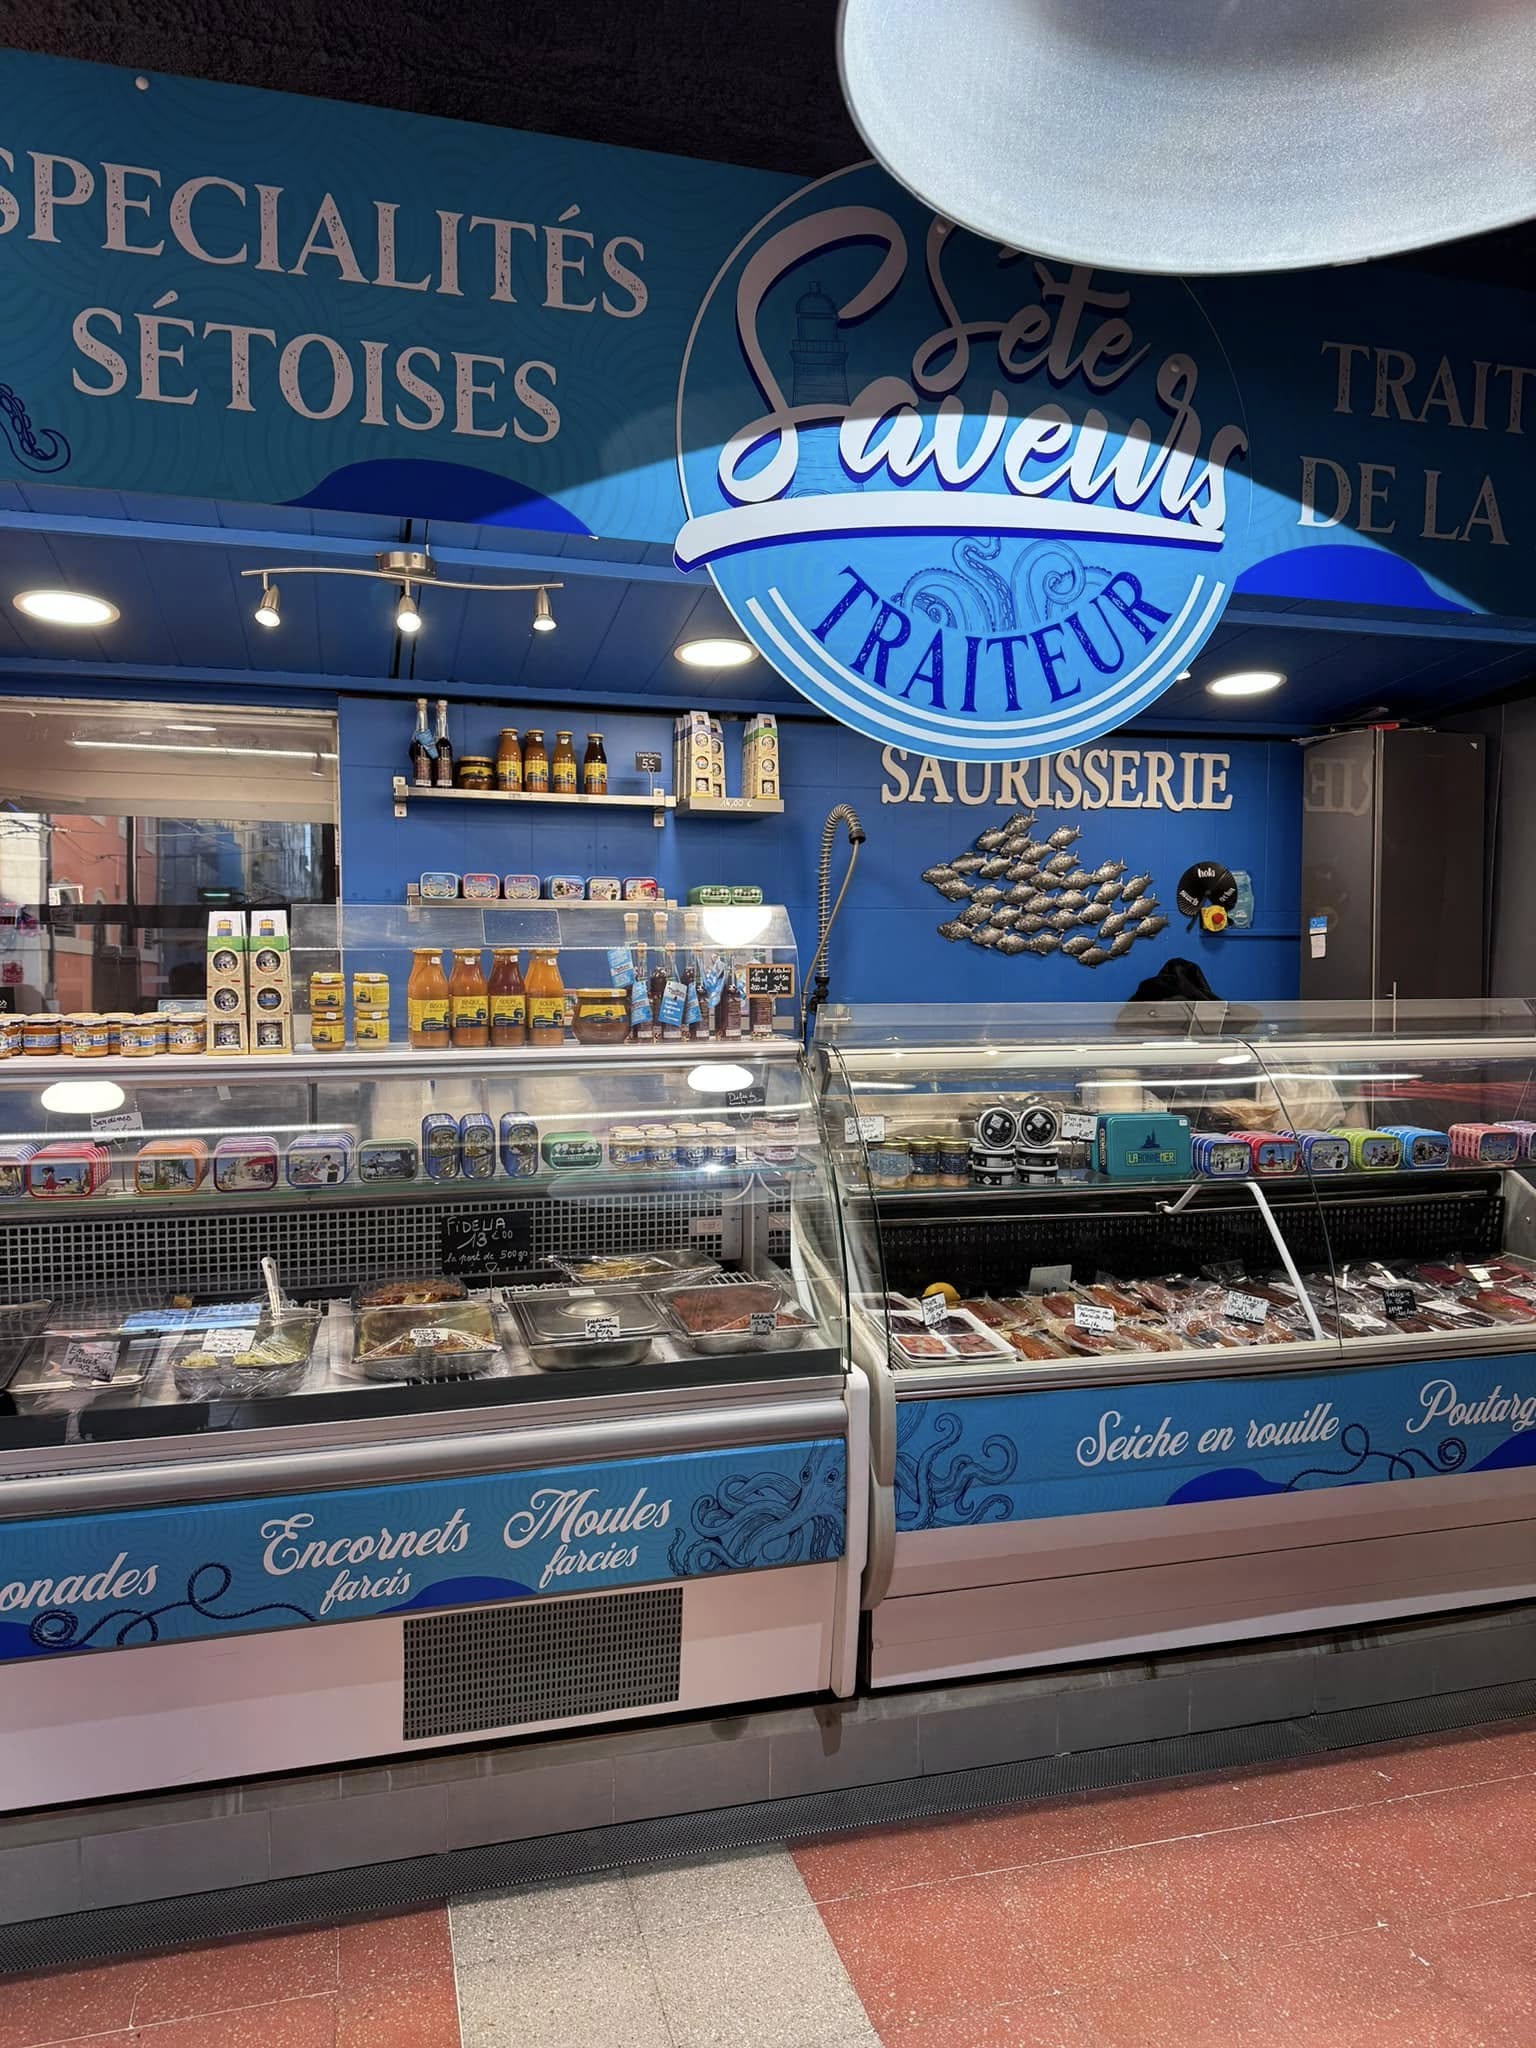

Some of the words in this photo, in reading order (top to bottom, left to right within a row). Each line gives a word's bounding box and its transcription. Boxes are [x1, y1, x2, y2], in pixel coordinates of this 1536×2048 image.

[72, 290, 561, 444] SÉTOISES
[718, 205, 1247, 532] Saveurs
[1320, 341, 1536, 434] TRAIT
[1297, 456, 1396, 533] DE
[1419, 469, 1510, 545] LA
[811, 566, 1173, 712] TRAITEUR
[881, 745, 1233, 811] SAURISSERIE
[1076, 1410, 1189, 1467] Seiche
[1197, 1427, 1236, 1453] en
[1246, 1402, 1340, 1449] rouille
[1406, 1379, 1536, 1433] Poutarg
[260, 1508, 470, 1576] Encornets
[503, 1487, 672, 1549] Moules
[0, 1551, 160, 1611] onades
[320, 1568, 411, 1615] farcis
[538, 1543, 638, 1588] farcies
